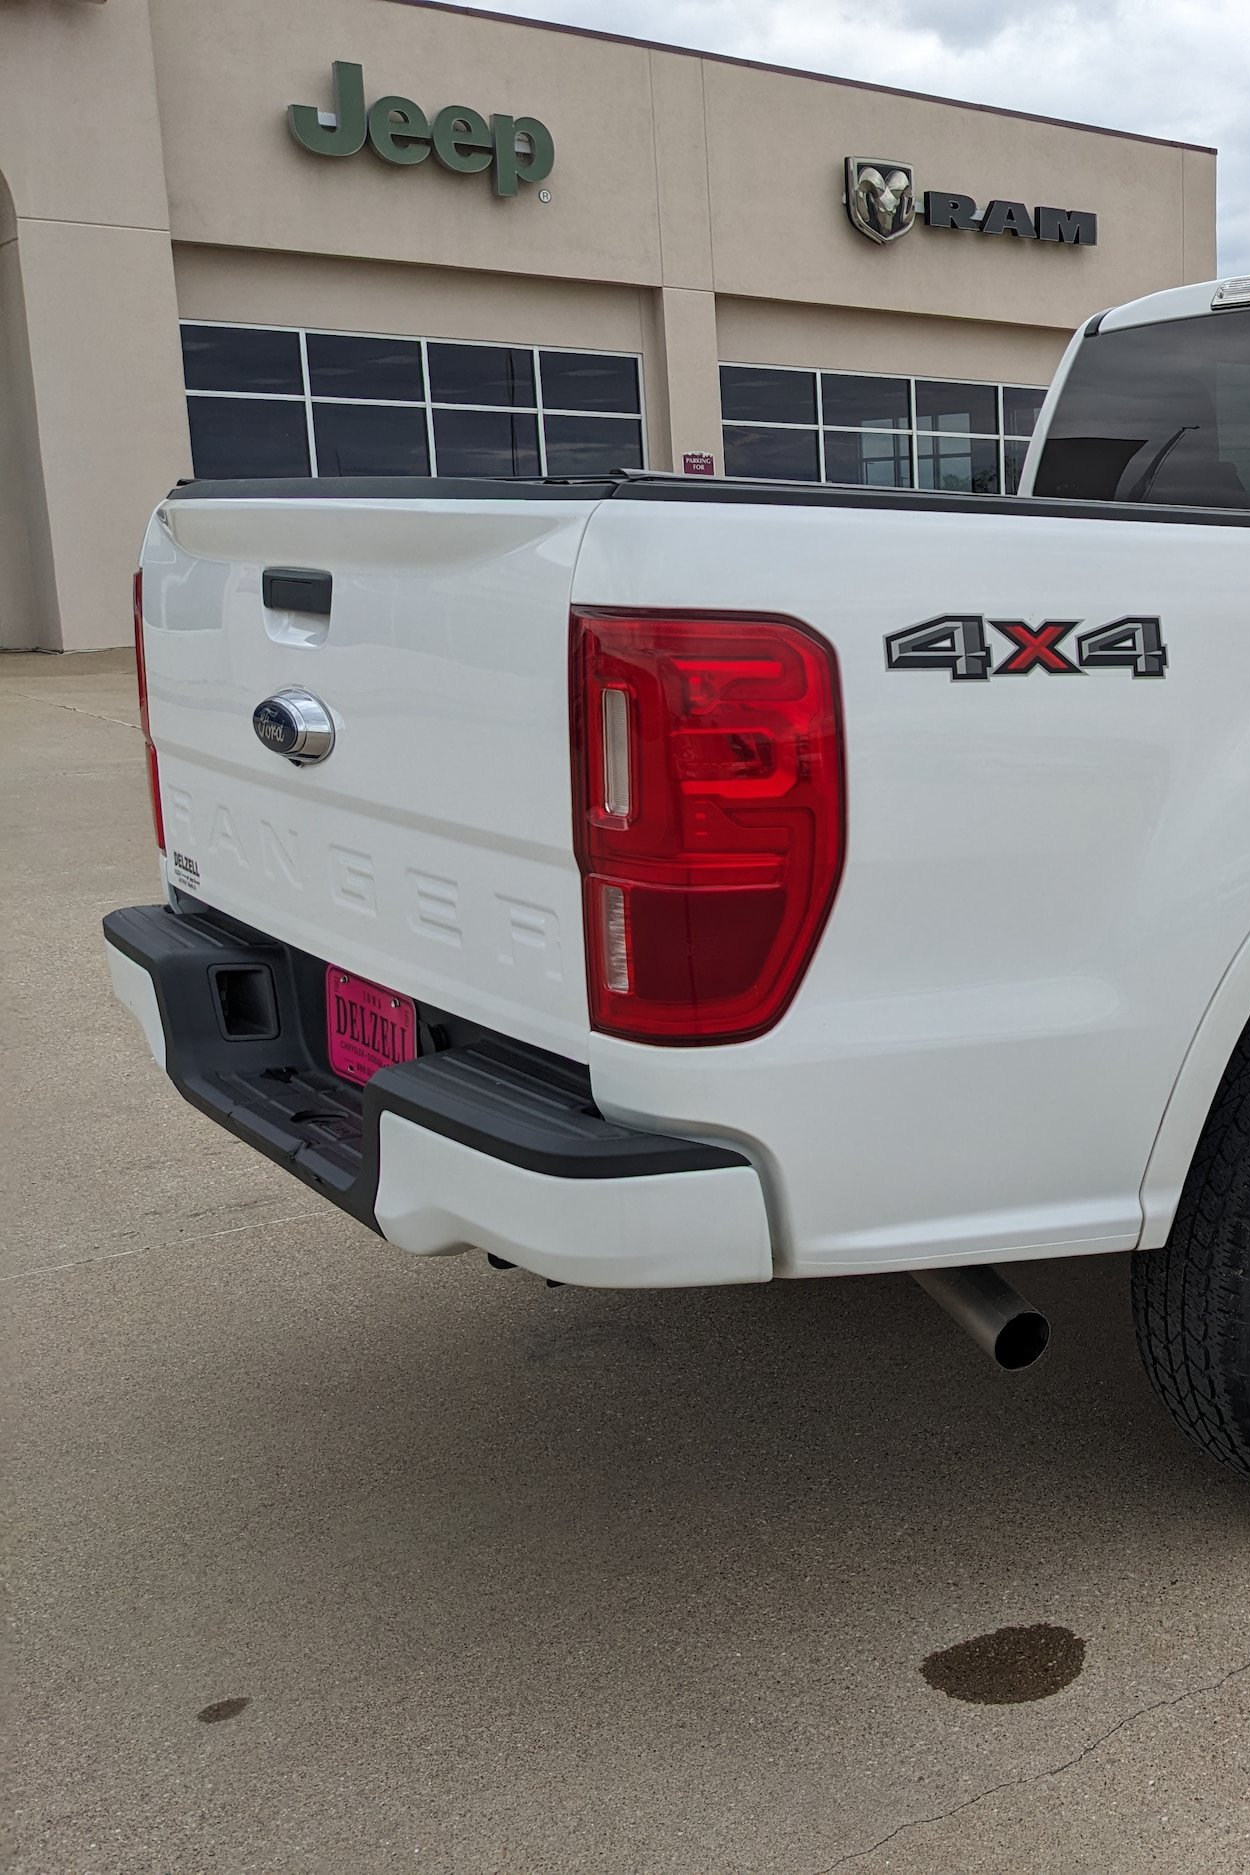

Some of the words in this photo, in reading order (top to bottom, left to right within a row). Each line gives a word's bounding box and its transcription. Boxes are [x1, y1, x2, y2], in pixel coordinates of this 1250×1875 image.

[287, 60, 555, 197] Jeep
[924, 191, 1098, 246] RAM
[258, 707, 285, 742] Ford
[167, 783, 564, 983] RANGER
[173, 850, 200, 878] DELZELL
